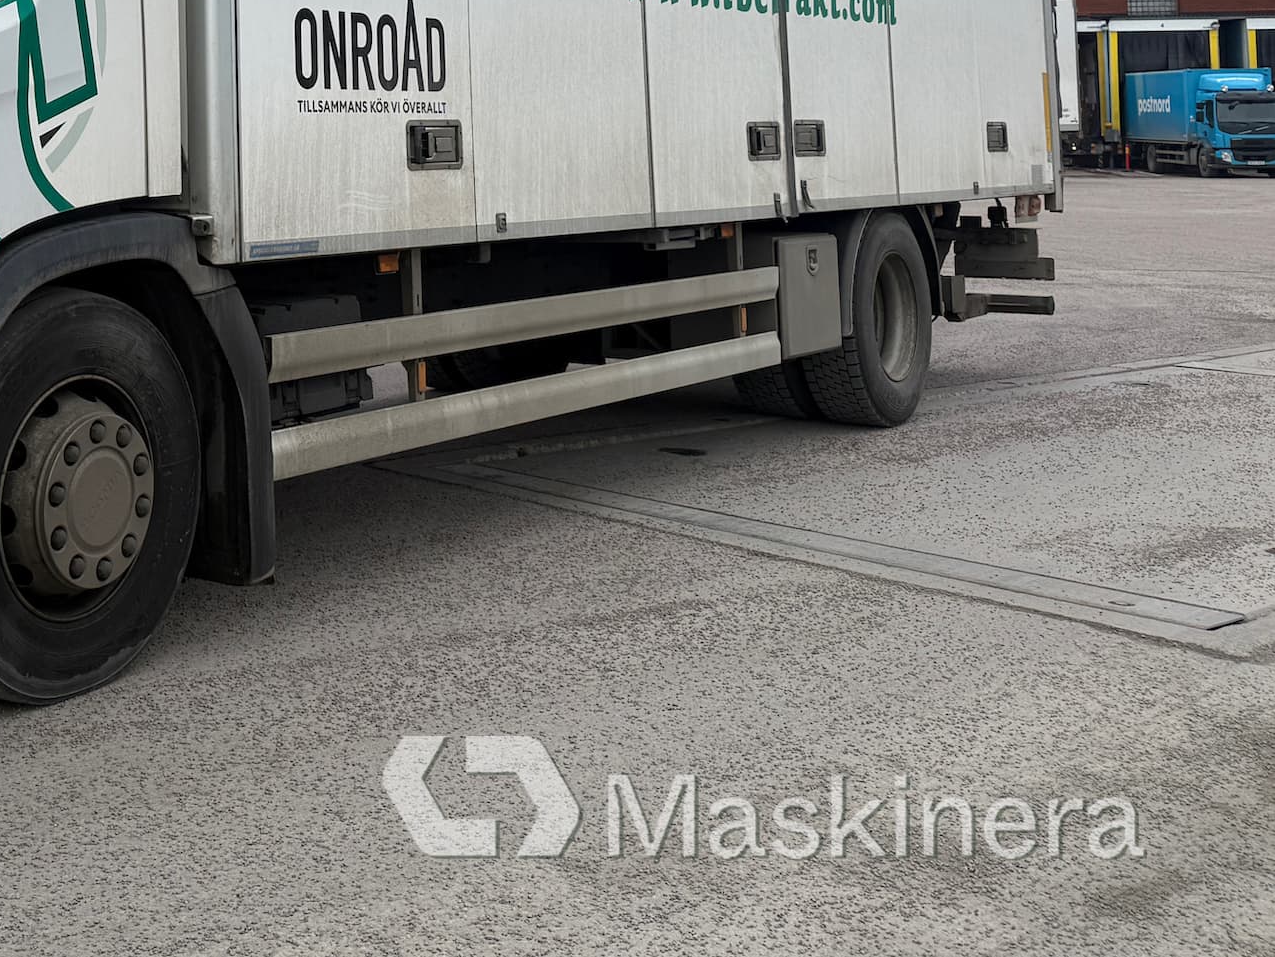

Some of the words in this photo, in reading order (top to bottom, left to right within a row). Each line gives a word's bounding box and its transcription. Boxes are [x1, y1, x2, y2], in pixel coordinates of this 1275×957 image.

[297, 100, 368, 114] TILLSAMMANS
[369, 98, 389, 114] KÖR
[392, 102, 401, 114] VI
[403, 99, 446, 114] ÖVERALLT
[1137, 95, 1171, 115] postnord
